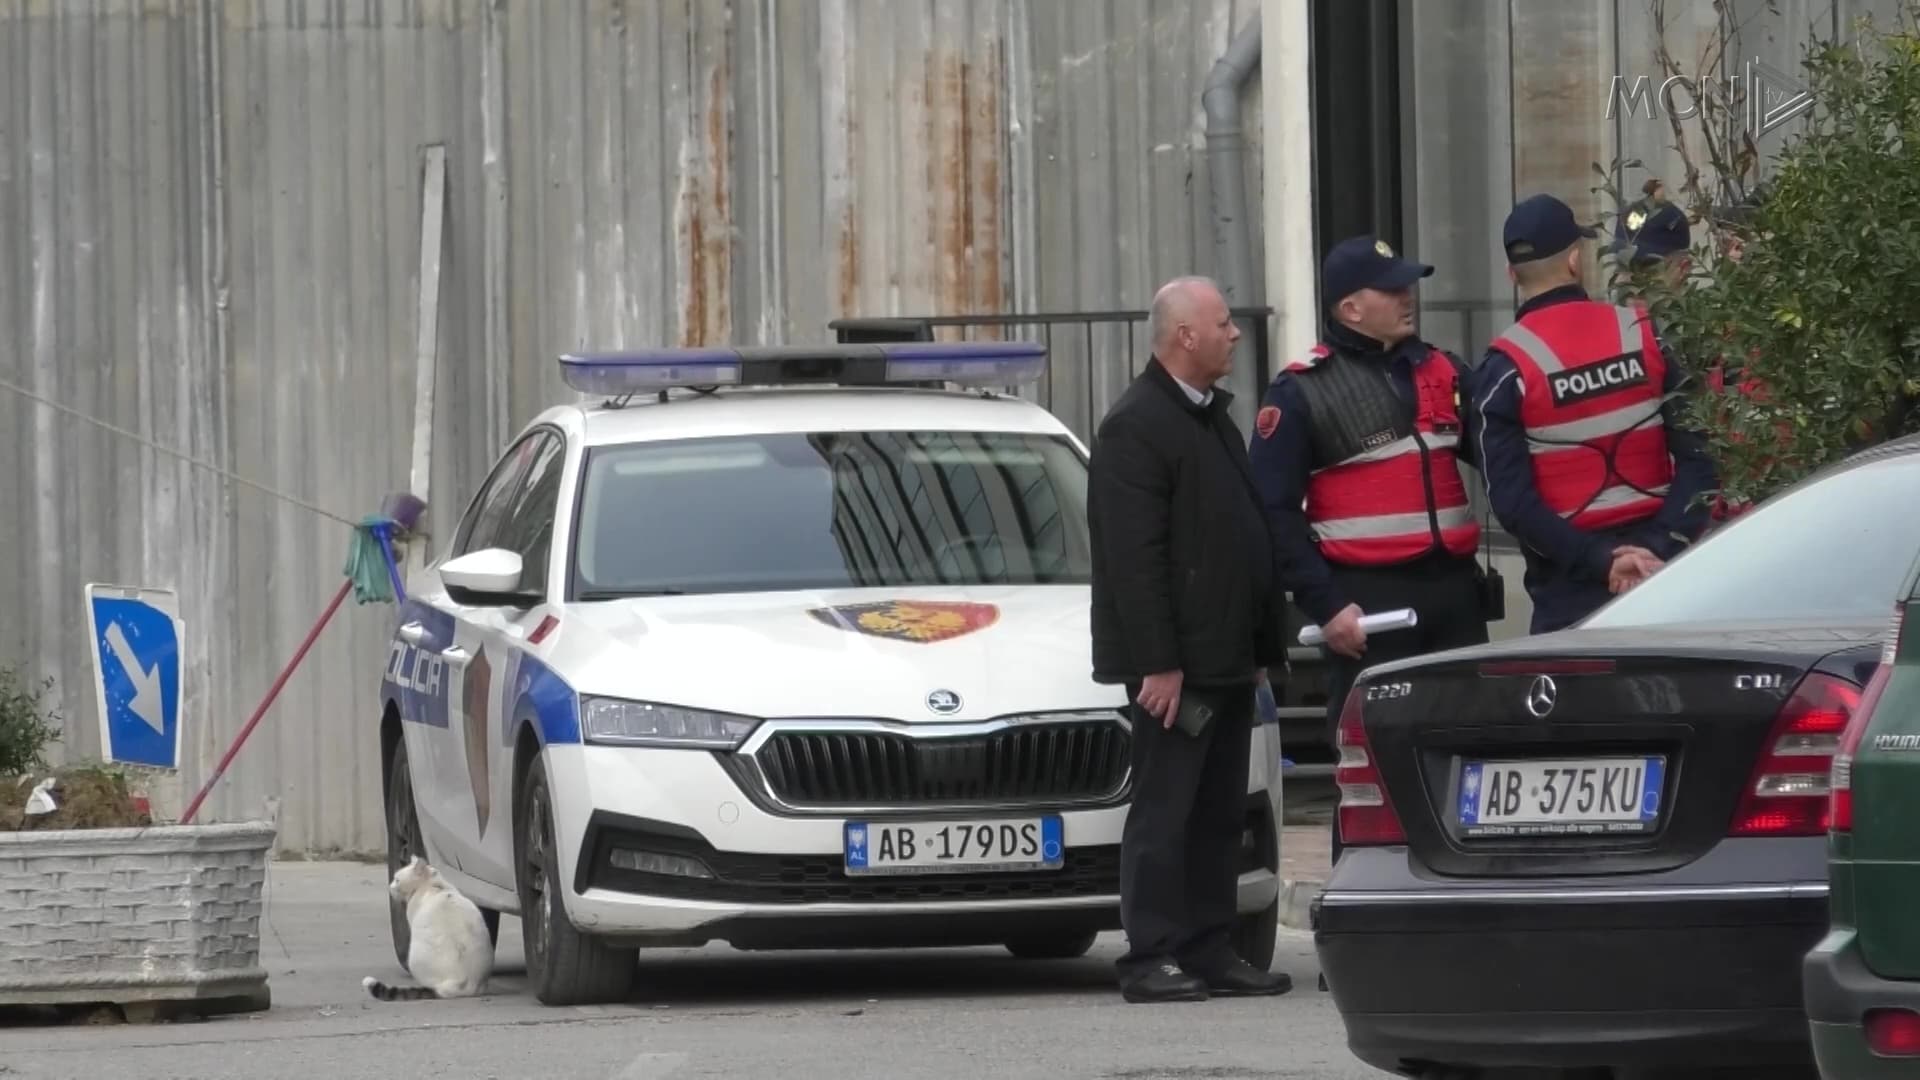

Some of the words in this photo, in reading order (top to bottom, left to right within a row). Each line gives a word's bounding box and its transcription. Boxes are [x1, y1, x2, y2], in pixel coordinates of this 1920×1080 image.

[1554, 358, 1645, 399] POLICIA
[384, 640, 443, 697] OLICIA
[1735, 673, 1782, 690] CDI
[1486, 770, 1523, 816] AB
[1539, 767, 1642, 814] 375KU
[850, 850, 865, 861] AL
[878, 827, 917, 861] AB
[936, 823, 1038, 859] 179DS
